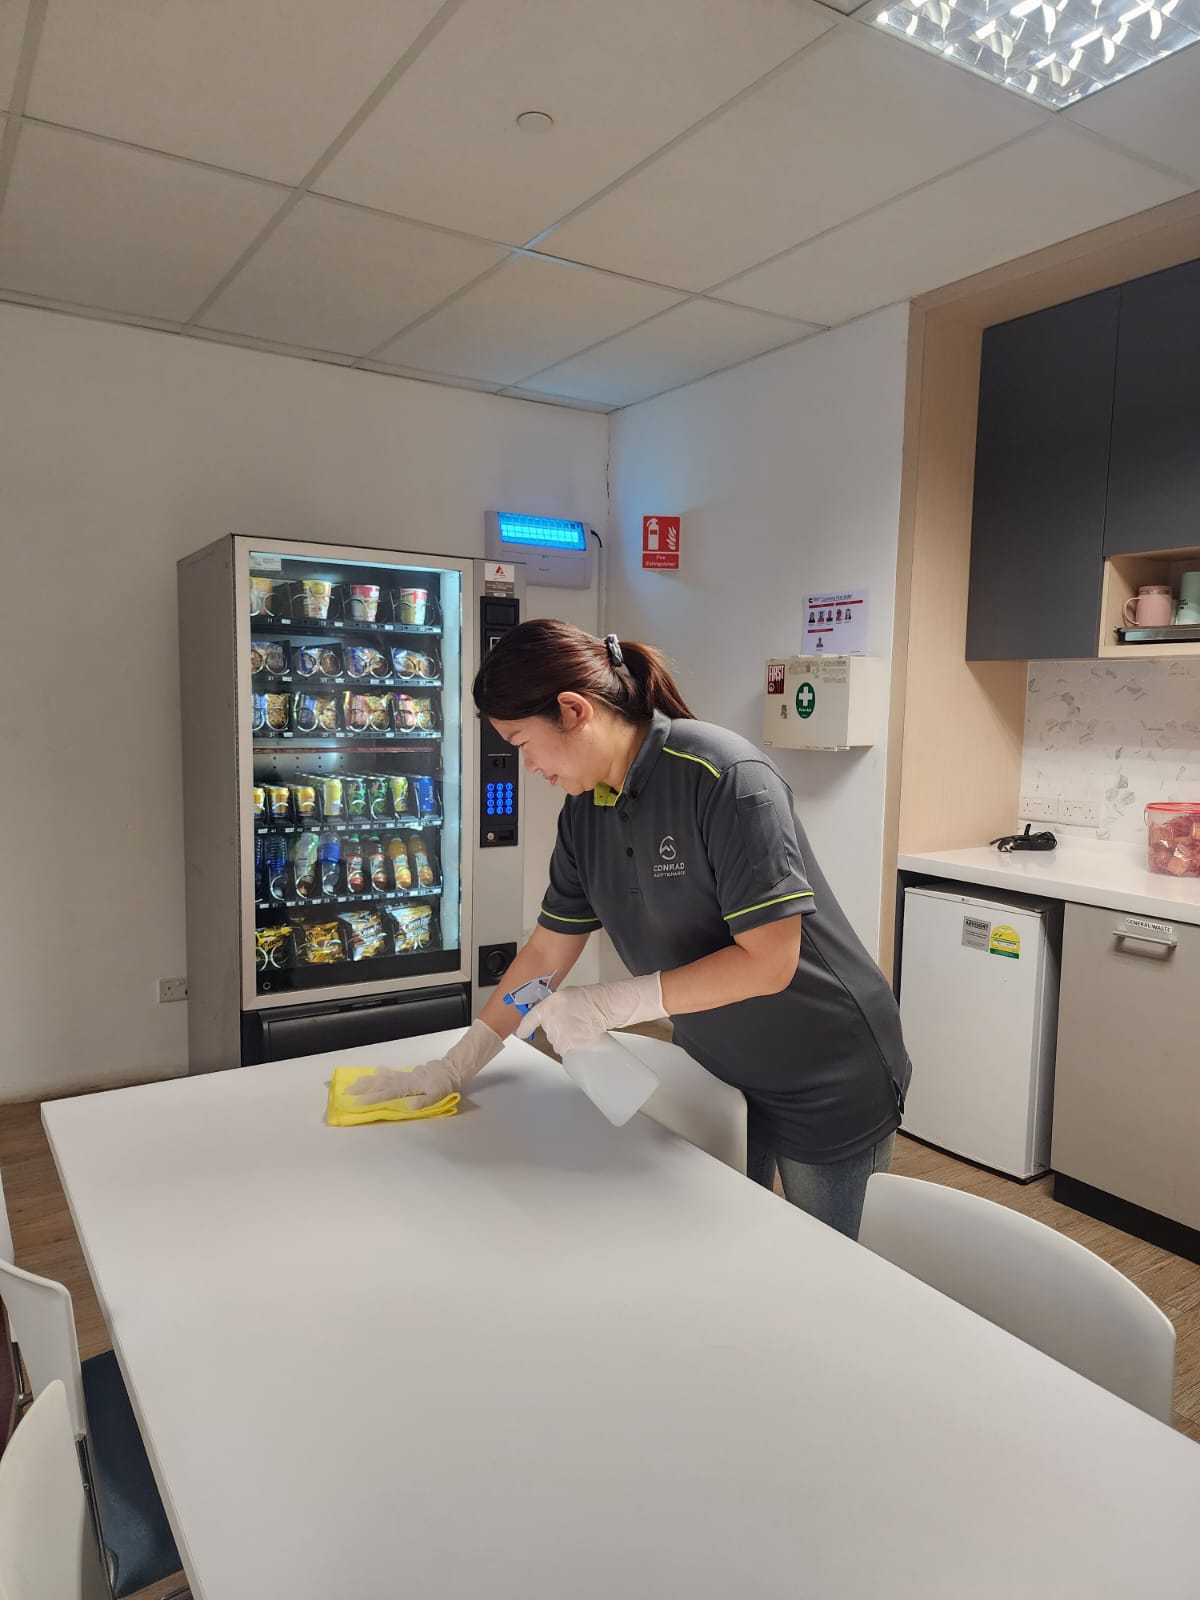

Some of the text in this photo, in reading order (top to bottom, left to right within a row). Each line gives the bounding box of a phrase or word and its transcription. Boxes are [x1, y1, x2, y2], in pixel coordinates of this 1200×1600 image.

[768, 665, 785, 682] FIRST
[653, 862, 685, 871] CONRAD
[1126, 918, 1171, 933] GENERAL WASTE
